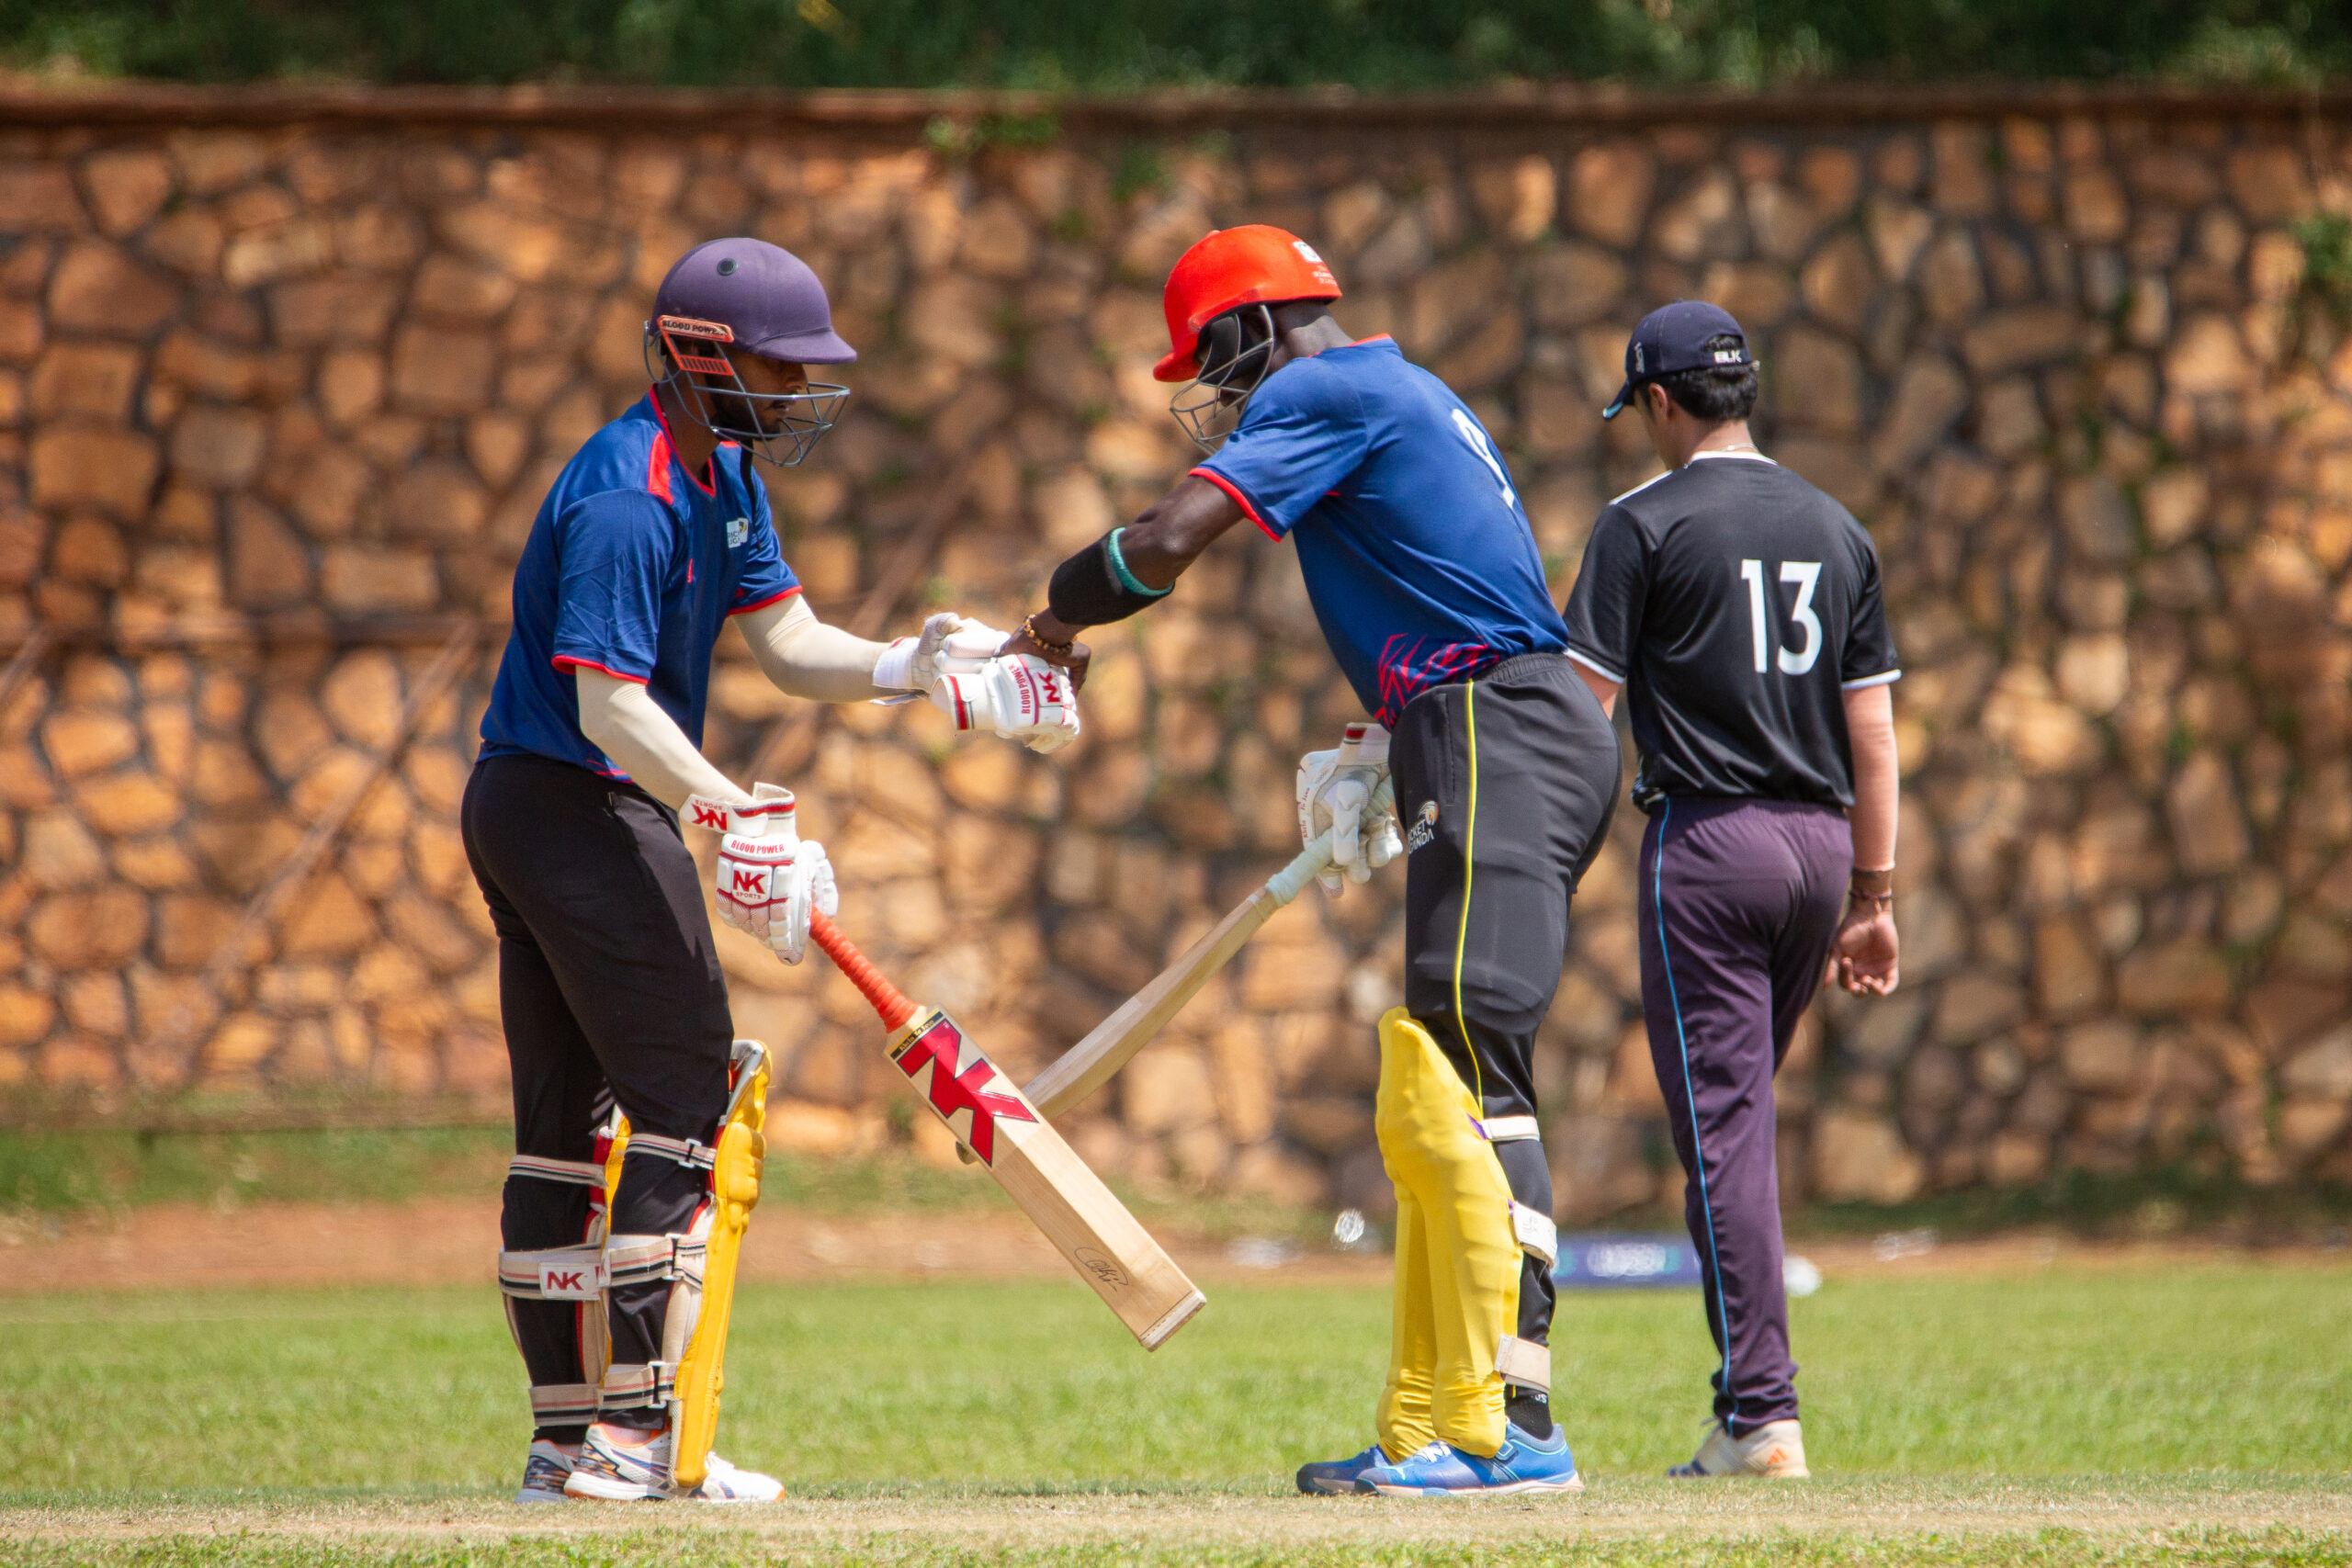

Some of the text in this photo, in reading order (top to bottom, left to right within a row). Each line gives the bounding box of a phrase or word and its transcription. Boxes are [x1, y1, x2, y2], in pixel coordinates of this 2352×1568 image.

[662, 320, 691, 331] BLOOD
[1740, 558, 1823, 676] 13
[1021, 689, 1031, 714] BLOOD
[695, 799, 723, 810] SPORTS
[690, 803, 728, 831] NK
[730, 840, 786, 855] BLOOD POWER
[732, 869, 766, 895] NK
[735, 891, 762, 900] SPORTS
[896, 1017, 1039, 1168] NK
[547, 1271, 584, 1292] NK
